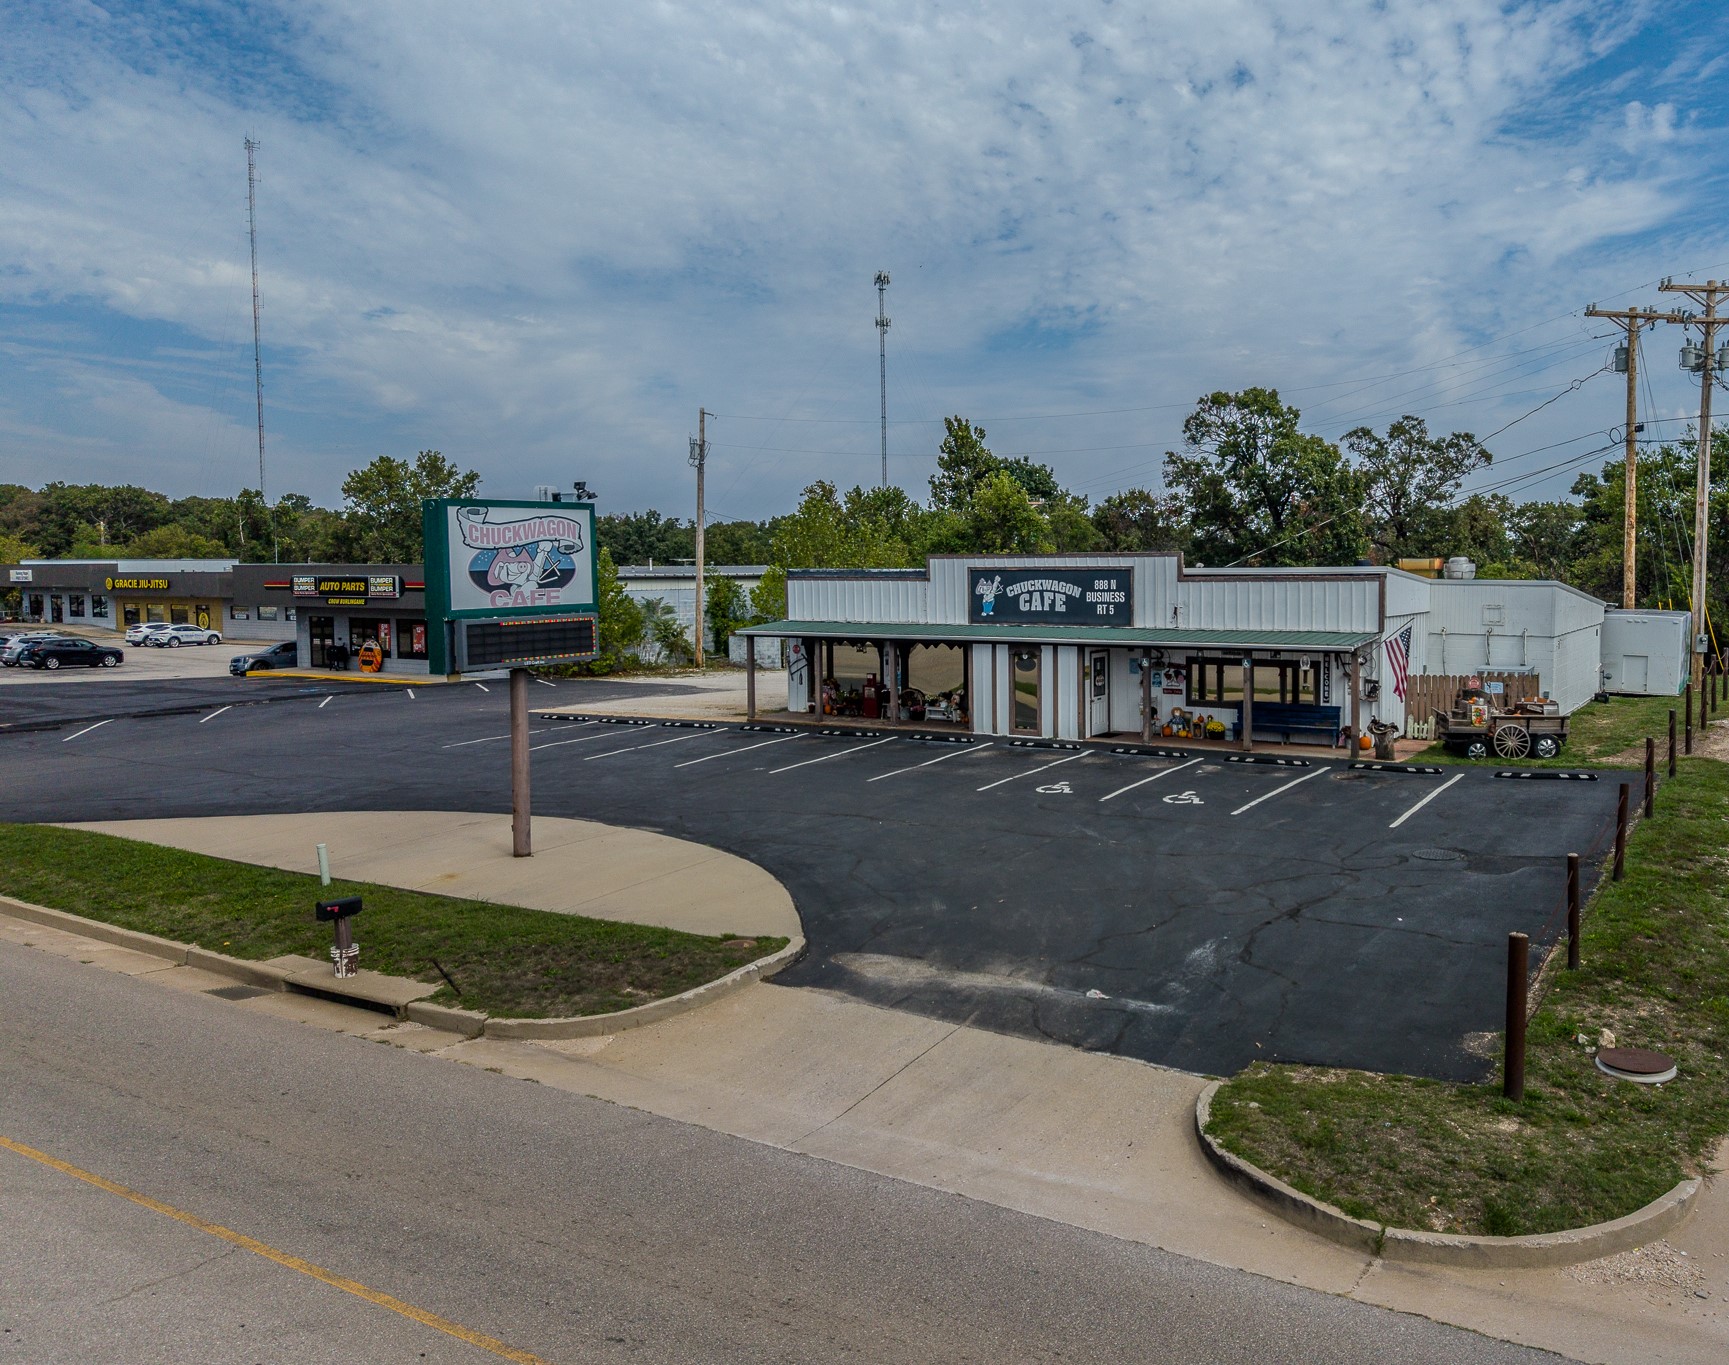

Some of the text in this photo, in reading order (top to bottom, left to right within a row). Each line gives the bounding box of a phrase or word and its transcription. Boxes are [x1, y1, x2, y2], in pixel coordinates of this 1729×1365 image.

[468, 519, 577, 546] CHUCKWAGON
[114, 579, 168, 589] GRACIE JIU-JITSU
[319, 582, 365, 591] AUTO PARTS
[1006, 579, 1082, 599] CHUCKWAGON
[1094, 580, 1117, 590] 888 N
[489, 587, 561, 608] CAFE
[1019, 592, 1067, 612] CAFE
[1086, 591, 1126, 603] BUSINESS
[1096, 604, 1115, 615] RT 5
